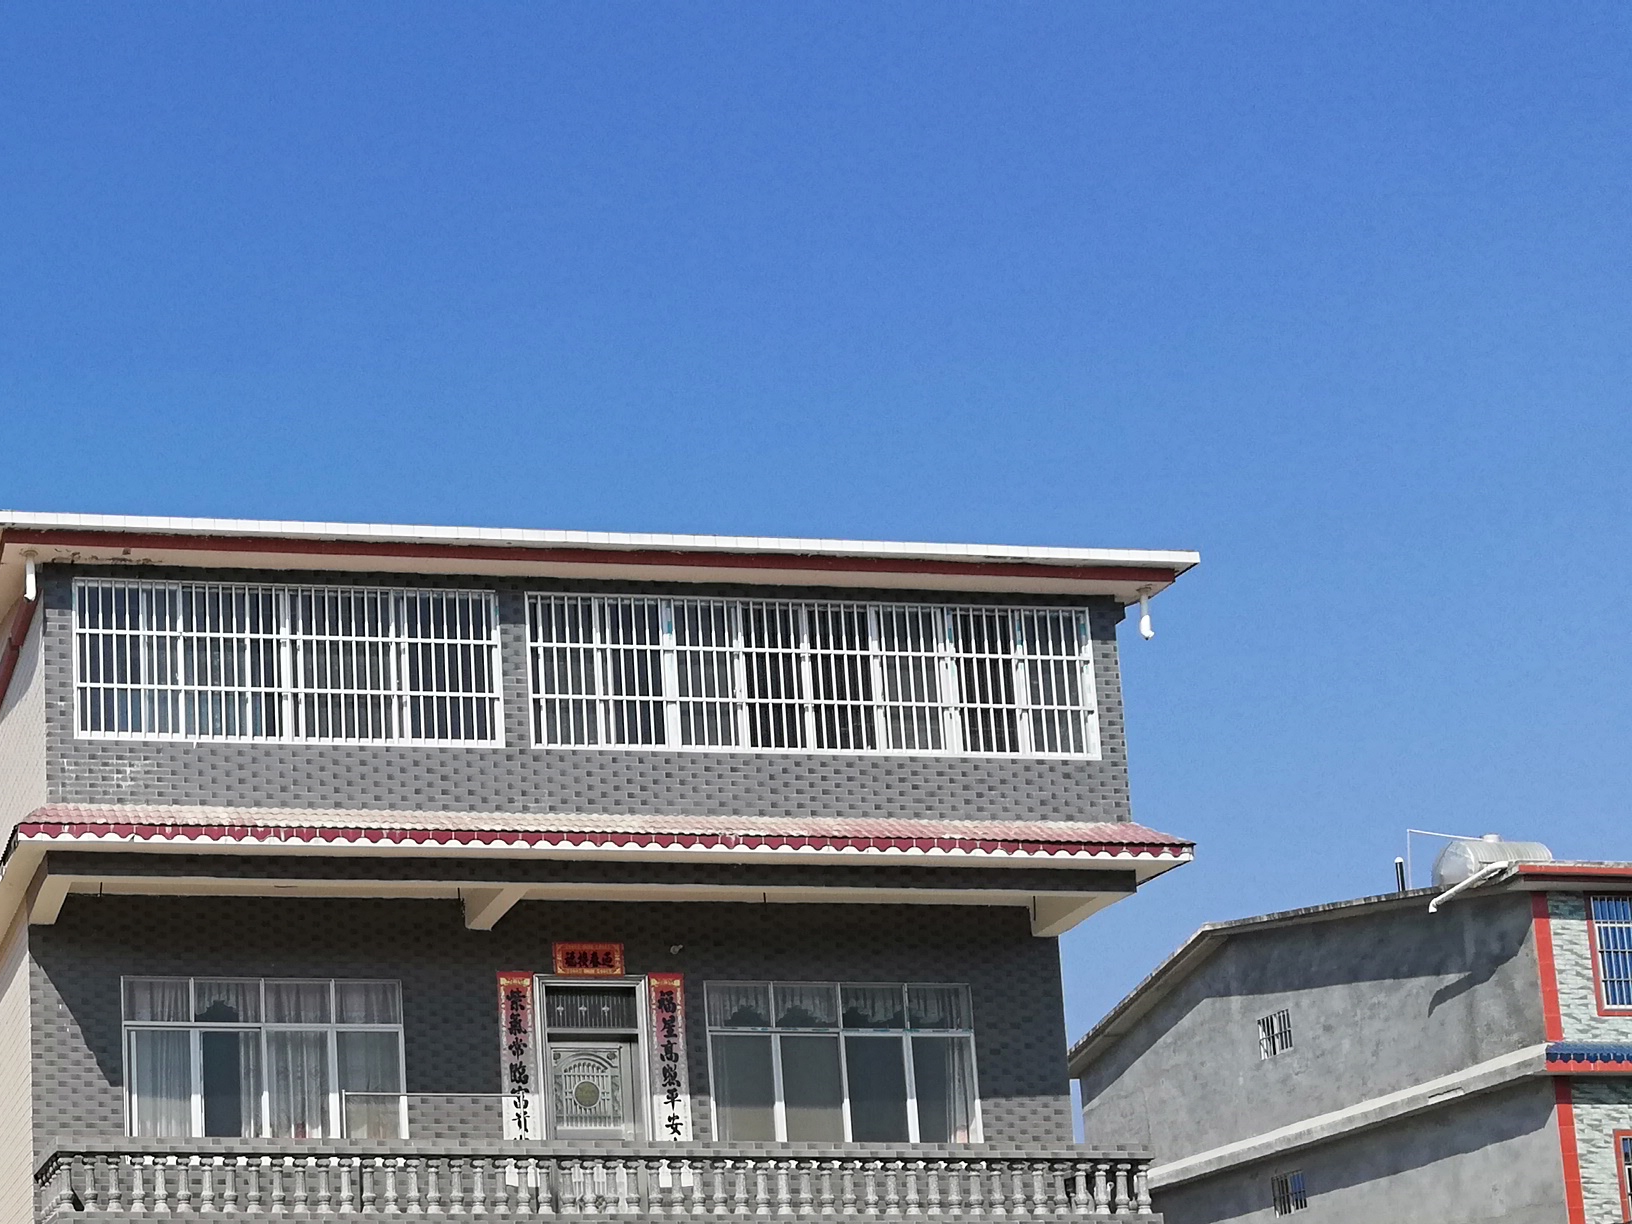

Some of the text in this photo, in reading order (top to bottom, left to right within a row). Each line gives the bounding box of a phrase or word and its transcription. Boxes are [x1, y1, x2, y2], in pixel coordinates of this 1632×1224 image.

[657, 990, 684, 1141] 福星高照平安
